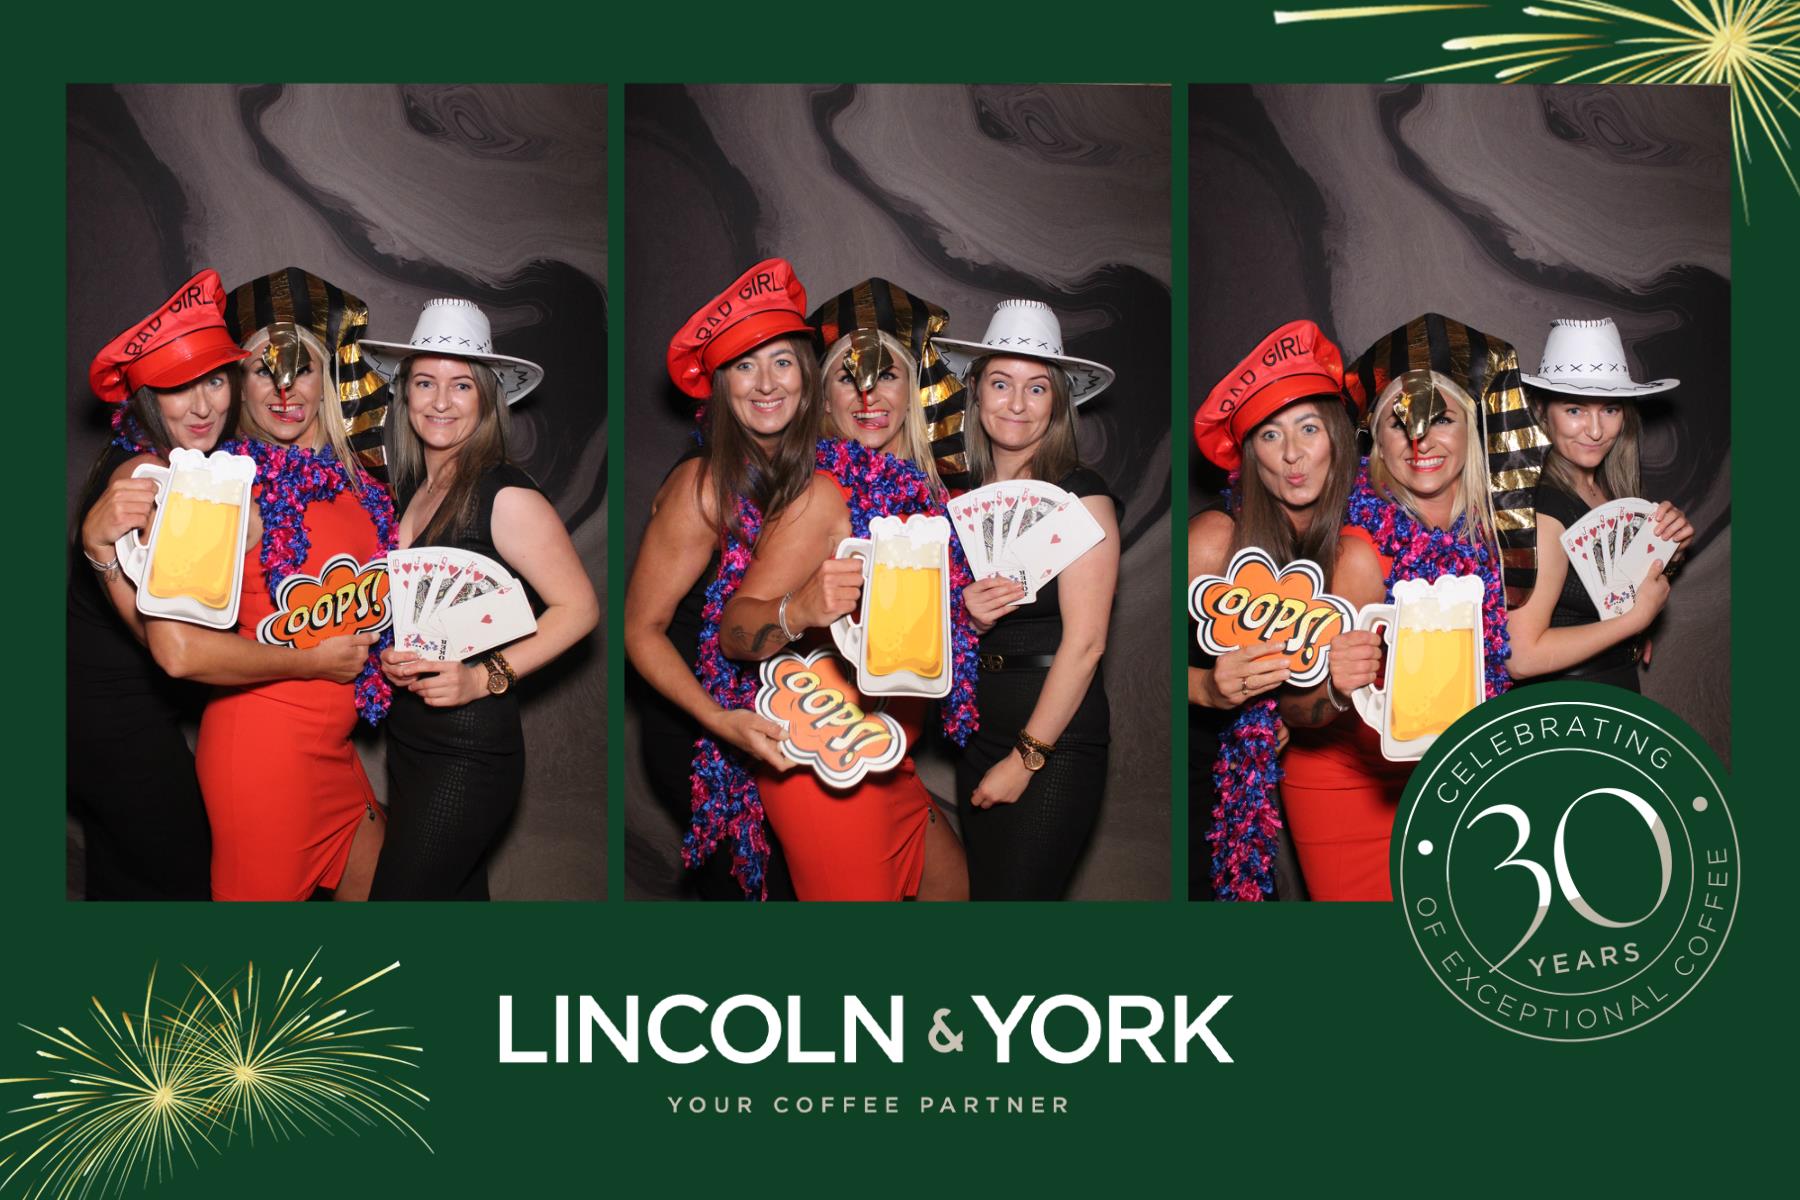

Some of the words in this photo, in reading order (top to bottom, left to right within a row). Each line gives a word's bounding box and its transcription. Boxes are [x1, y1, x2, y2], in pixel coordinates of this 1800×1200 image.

[696, 300, 733, 341] BAD
[738, 271, 785, 300] GIRL
[1262, 335, 1310, 367] GIRL
[284, 569, 385, 636] OOPS!
[1212, 586, 1343, 665] OOPS!
[782, 671, 893, 767] OOPS!
